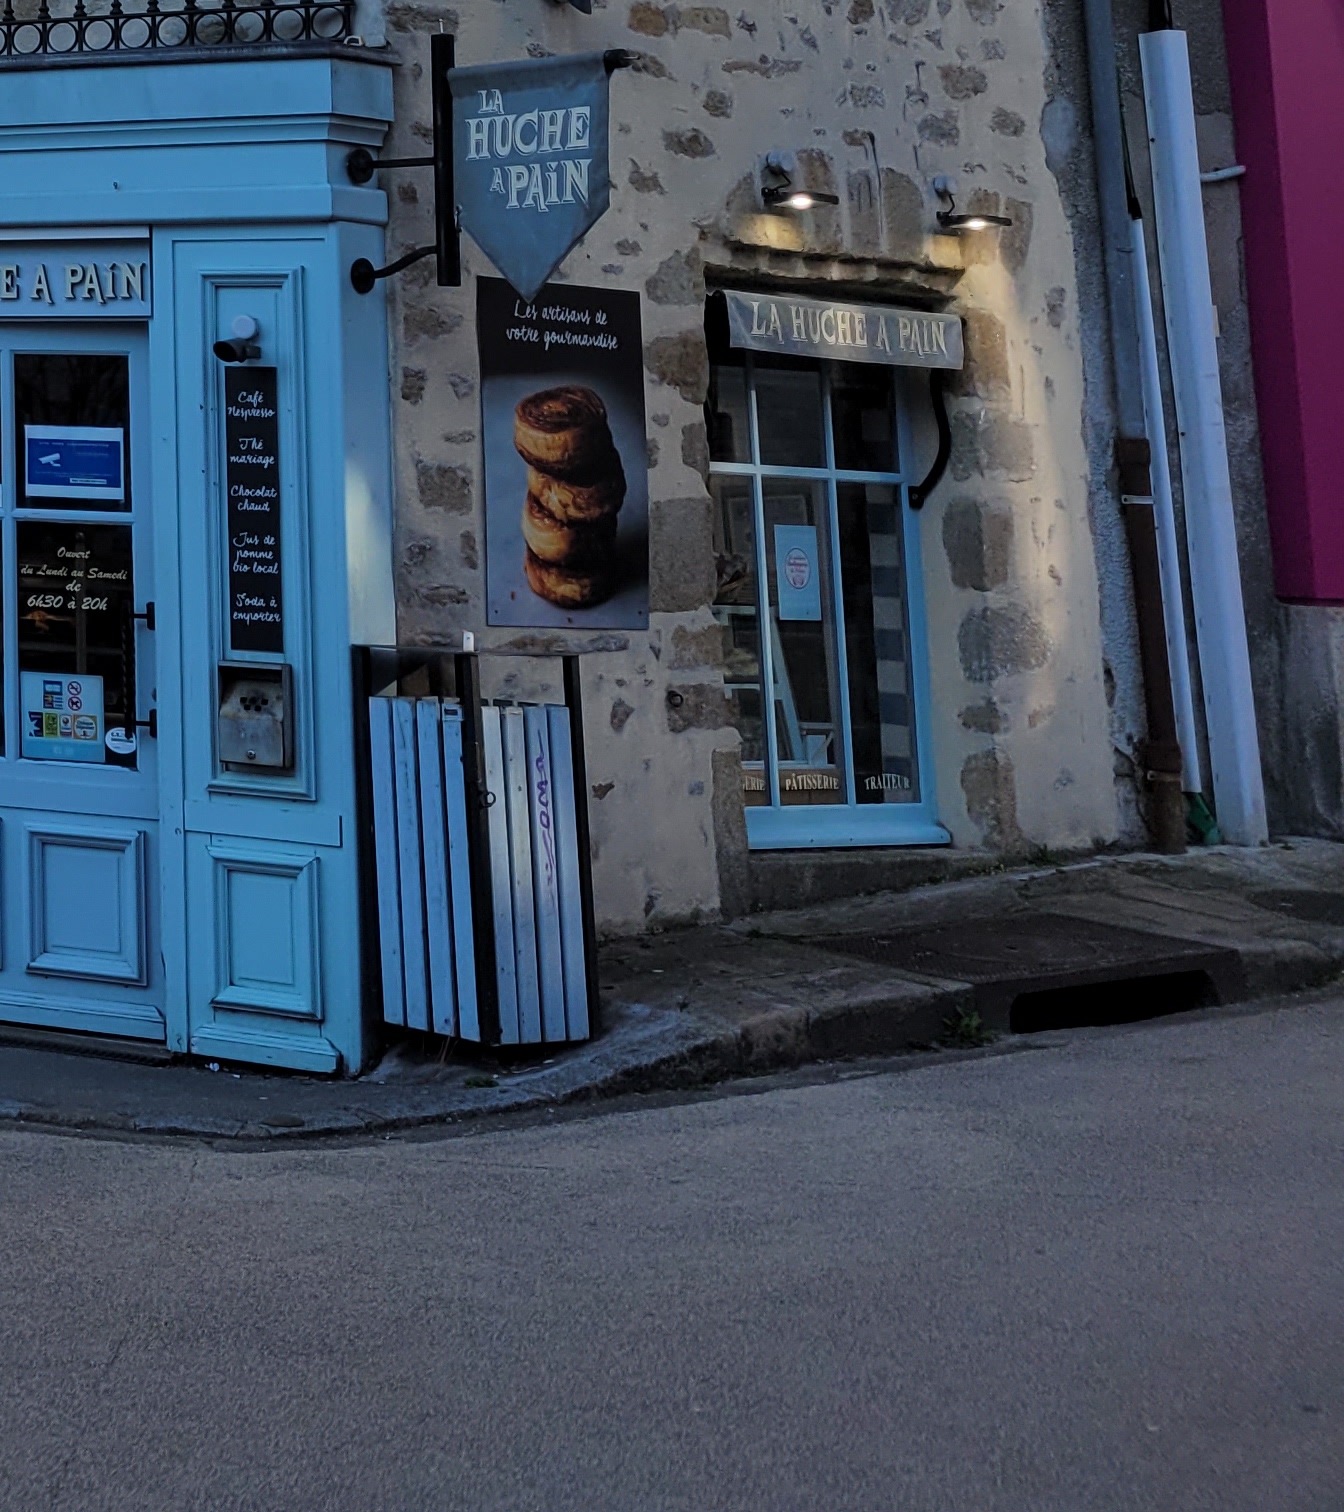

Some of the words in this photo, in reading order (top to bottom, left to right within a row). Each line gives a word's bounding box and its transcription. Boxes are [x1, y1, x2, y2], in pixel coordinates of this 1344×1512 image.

[478, 89, 504, 114] LA
[465, 106, 590, 160] HUCHE
[490, 167, 505, 194] A
[30, 264, 54, 305] A
[514, 299, 537, 320] Les
[542, 305, 591, 325] artisans
[595, 309, 608, 325] de
[750, 301, 784, 345] LA
[789, 305, 869, 347] HUCHE
[876, 315, 892, 355] A
[506, 325, 540, 342] votre
[544, 330, 618, 350] gourmandise
[237, 390, 264, 408] Café
[238, 437, 264, 450] Thé
[230, 454, 275, 469] mariage
[231, 484, 277, 498] Chocolat
[237, 498, 270, 512] chaud
[233, 532, 259, 547] Jus
[264, 534, 275, 545] de
[57, 547, 91, 559] Ouvert
[236, 549, 274, 563] pomme
[21, 565, 33, 574] du
[36, 564, 68, 576] Lundi
[87, 568, 128, 580] Samedi
[233, 560, 250, 572] bio
[253, 561, 279, 574] local
[65, 580, 82, 592] de
[27, 594, 64, 608] 6h30
[67, 596, 76, 609] à
[81, 597, 108, 610] 20h
[236, 592, 266, 607] Soda
[270, 596, 277, 608] à
[233, 611, 281, 626] emporter
[785, 772, 839, 791] PÂTISSERIE
[864, 773, 911, 790] TRAITEUR
